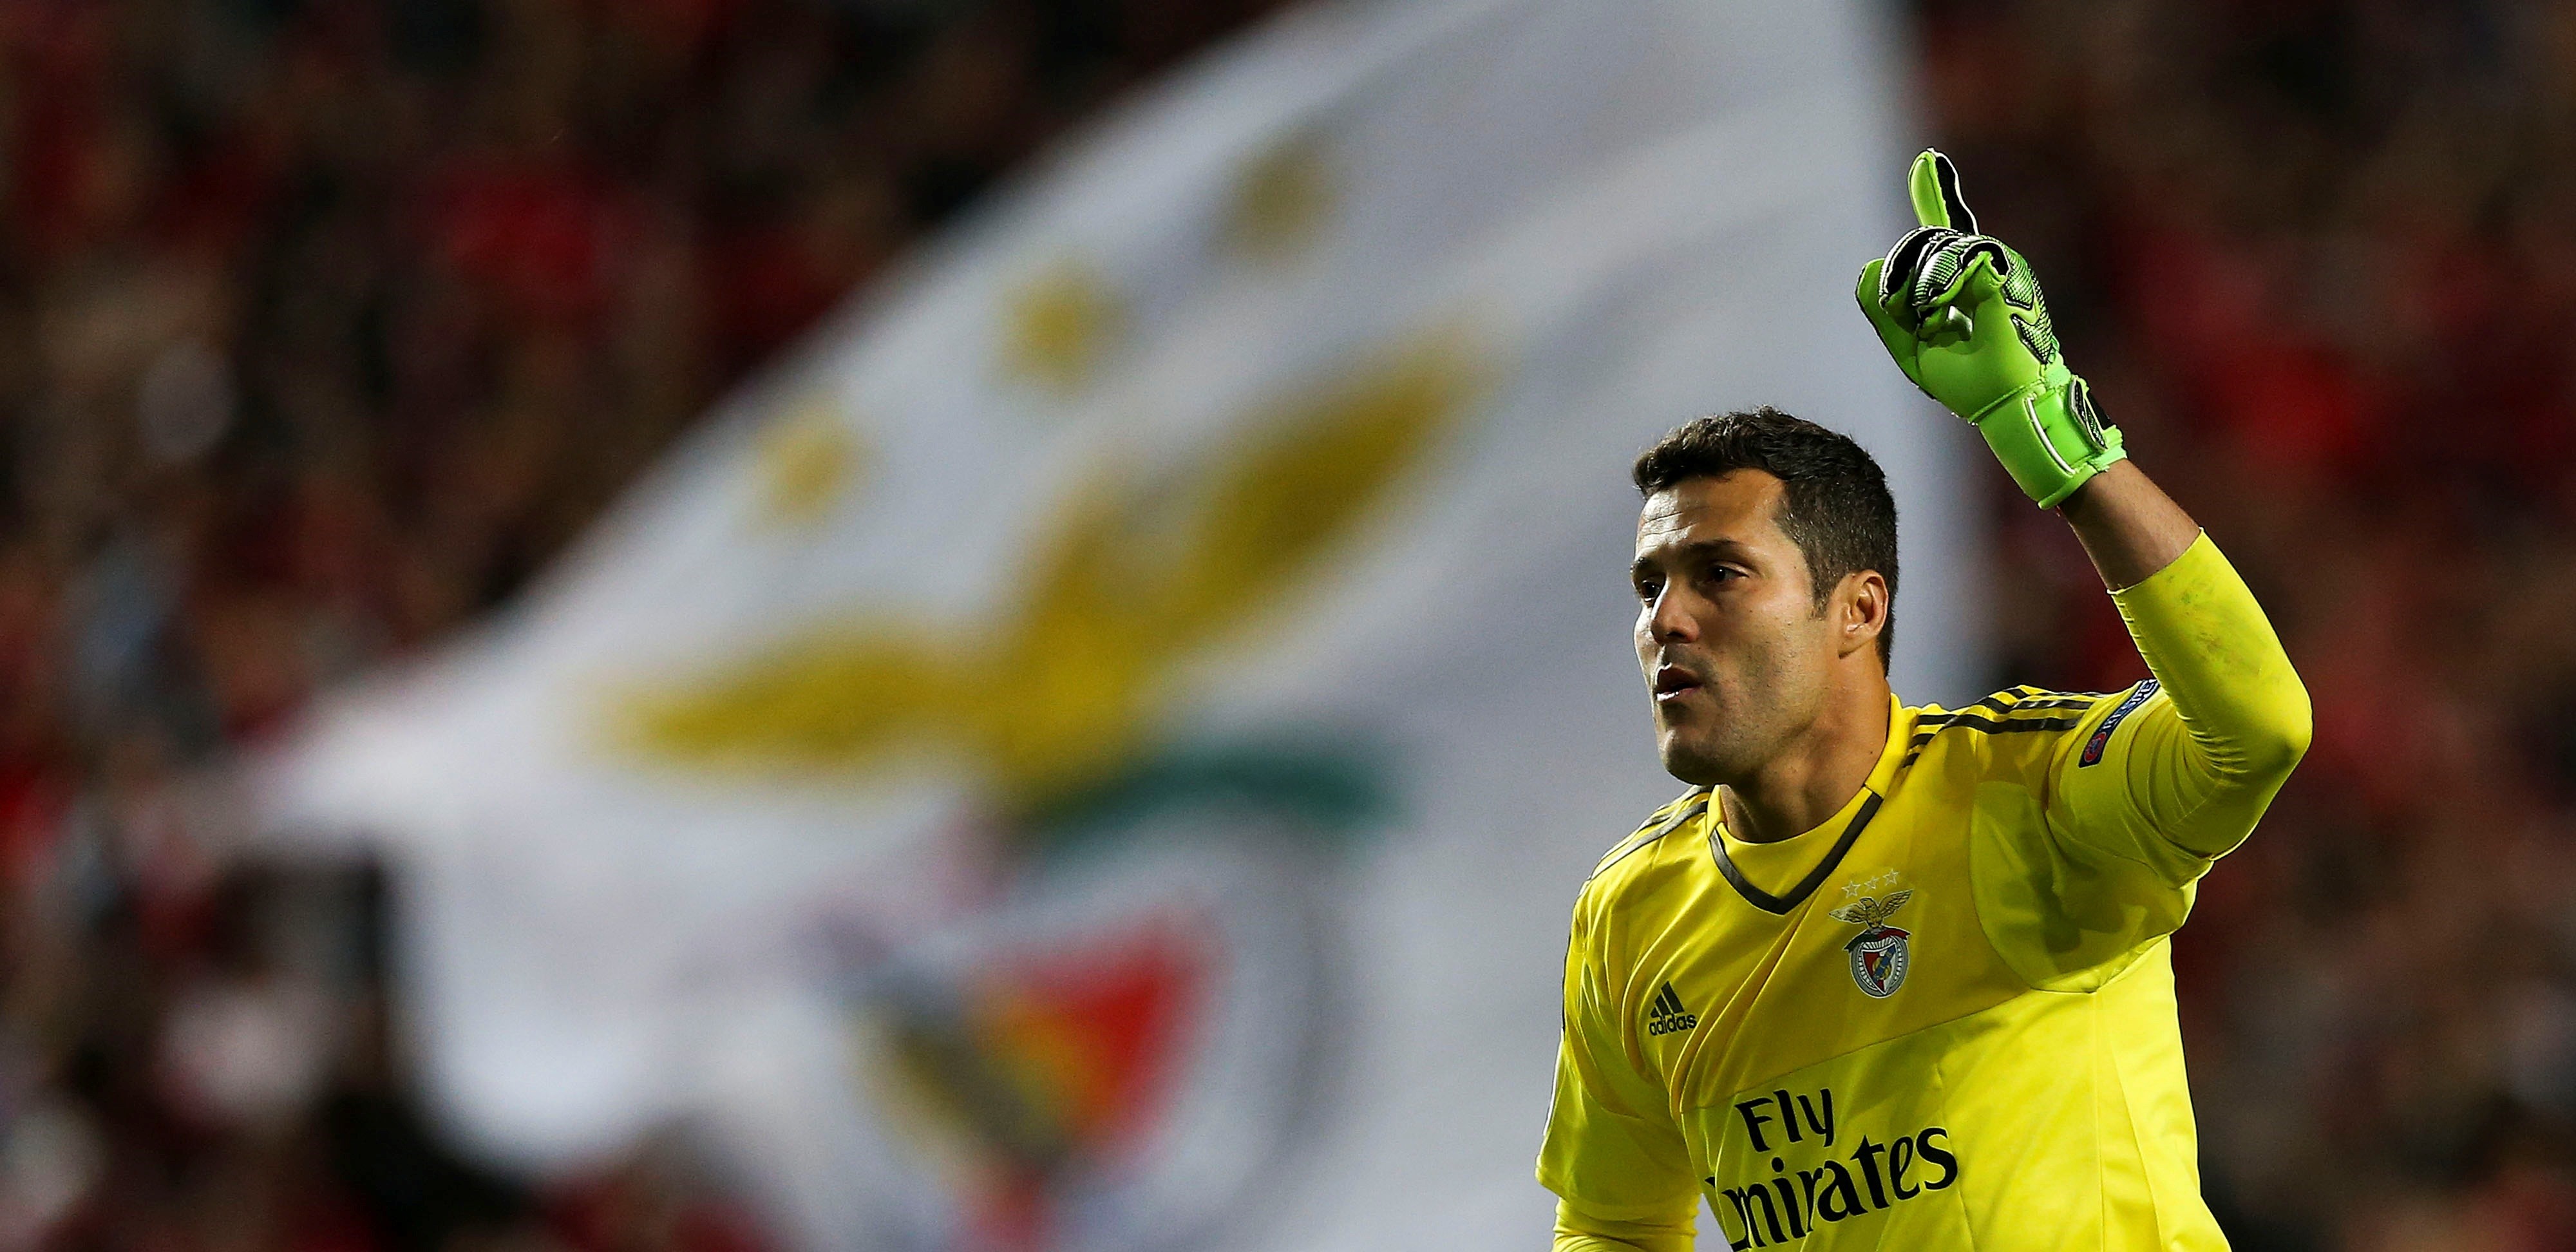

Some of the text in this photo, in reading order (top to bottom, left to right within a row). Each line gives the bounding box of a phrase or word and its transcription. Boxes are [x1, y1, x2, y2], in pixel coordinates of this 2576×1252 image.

[1649, 1013, 1697, 1036] adidas
[1734, 1088, 1834, 1153] Fly
[1705, 1127, 1958, 1252] mirates
